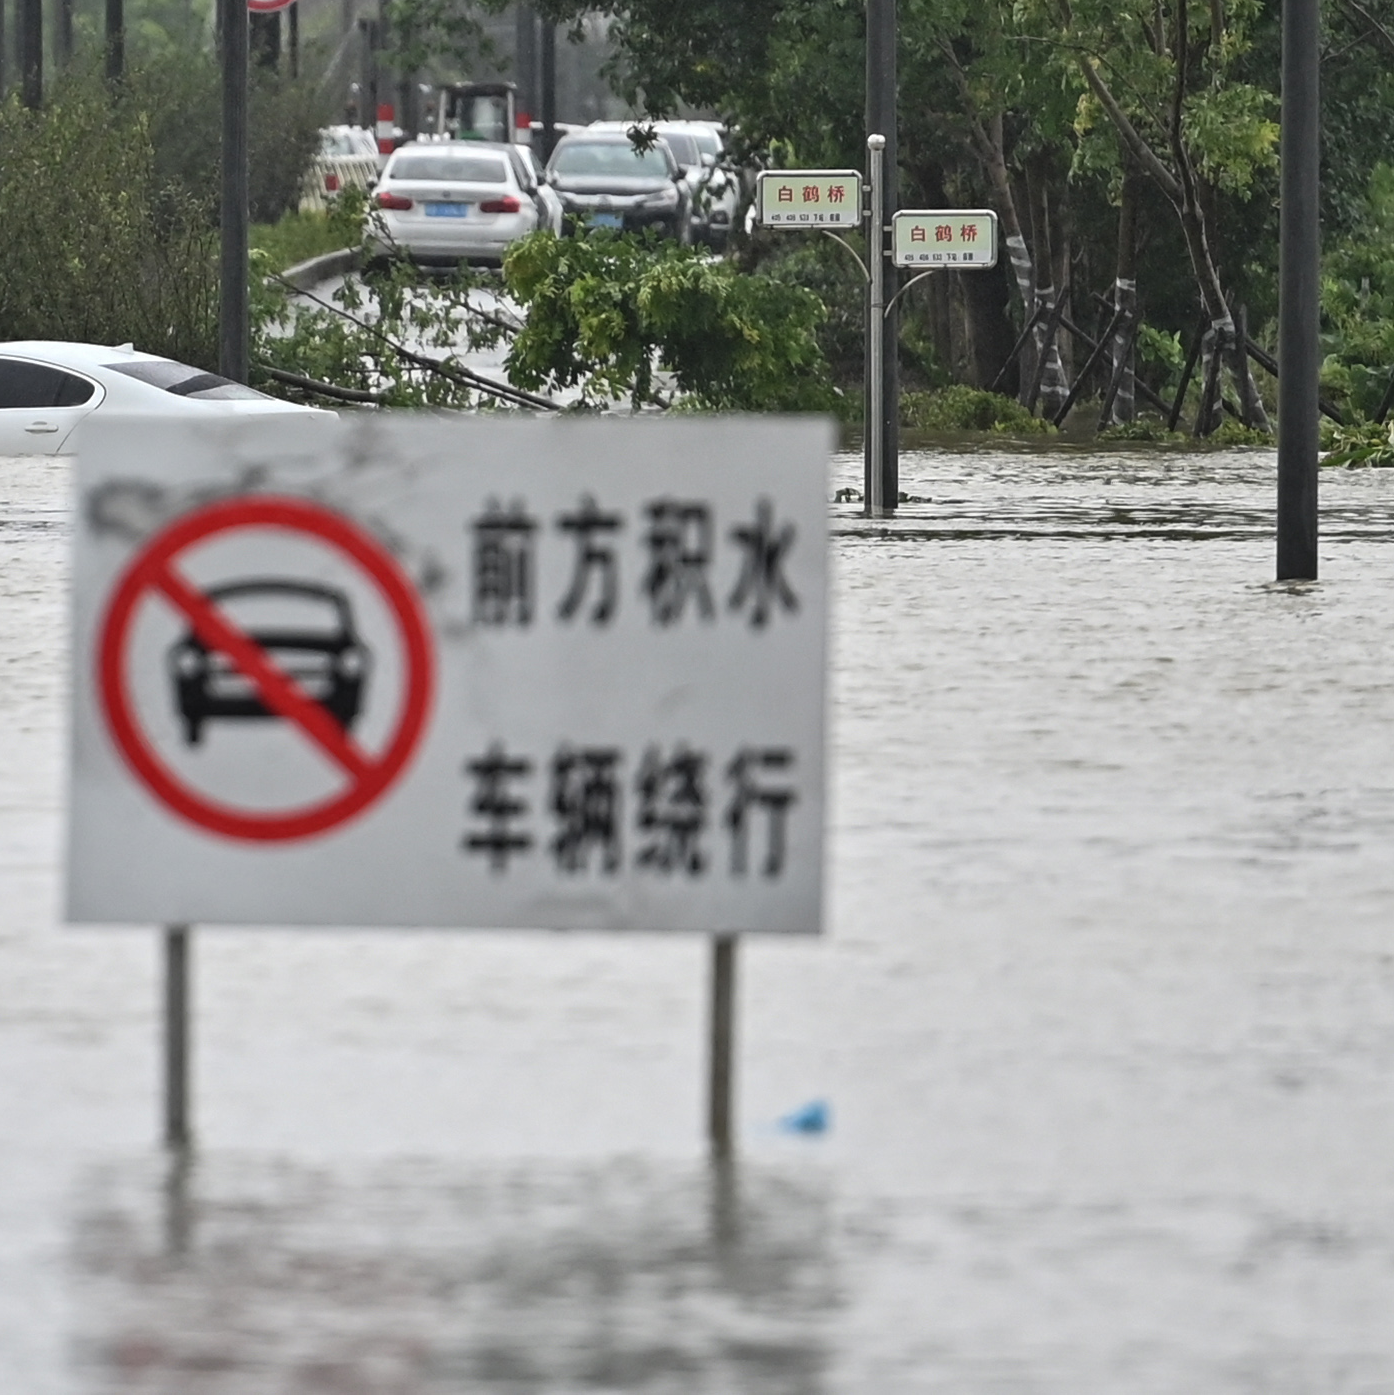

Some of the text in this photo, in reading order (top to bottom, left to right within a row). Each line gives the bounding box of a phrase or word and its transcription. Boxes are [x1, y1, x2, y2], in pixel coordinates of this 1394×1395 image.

[778, 185, 845, 203] 白鹤桥
[911, 224, 978, 243] 白鹤桥
[465, 496, 802, 632] 前方积水
[461, 742, 798, 879] 车辆绕行
